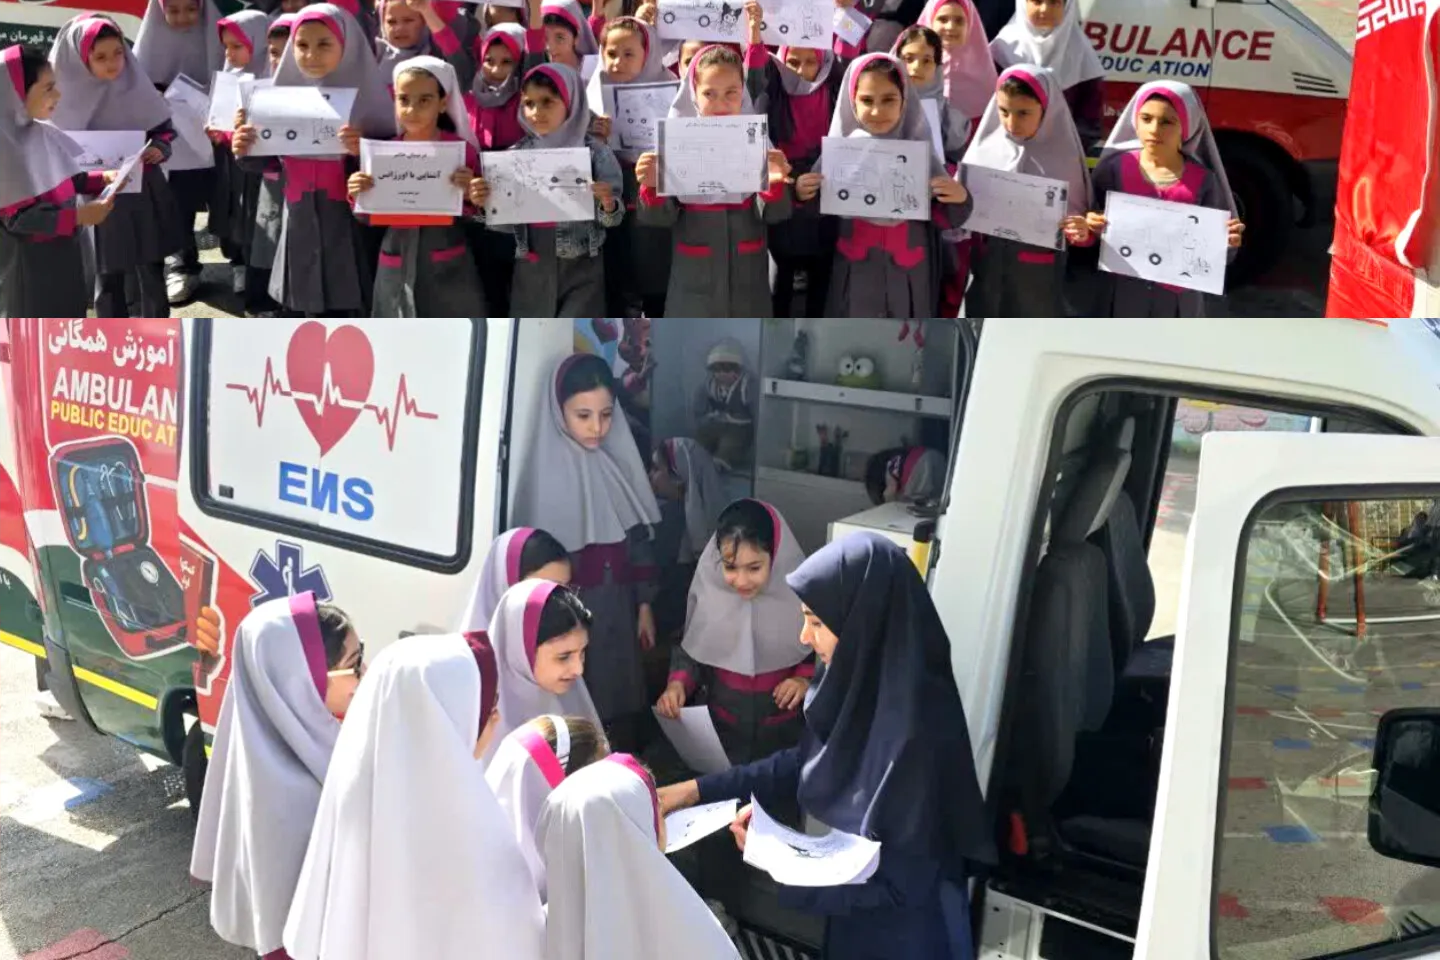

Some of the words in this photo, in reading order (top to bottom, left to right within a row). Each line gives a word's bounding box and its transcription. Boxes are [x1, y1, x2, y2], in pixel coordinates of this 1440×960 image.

[1084, 20, 1275, 61] BULANCE
[1098, 56, 1143, 73] DUC
[1147, 60, 1212, 78] ATION
[48, 319, 107, 354] همگانی
[113, 329, 176, 372] آموزش
[50, 399, 105, 430] PUBLIC
[52, 367, 177, 424] AMBULAN
